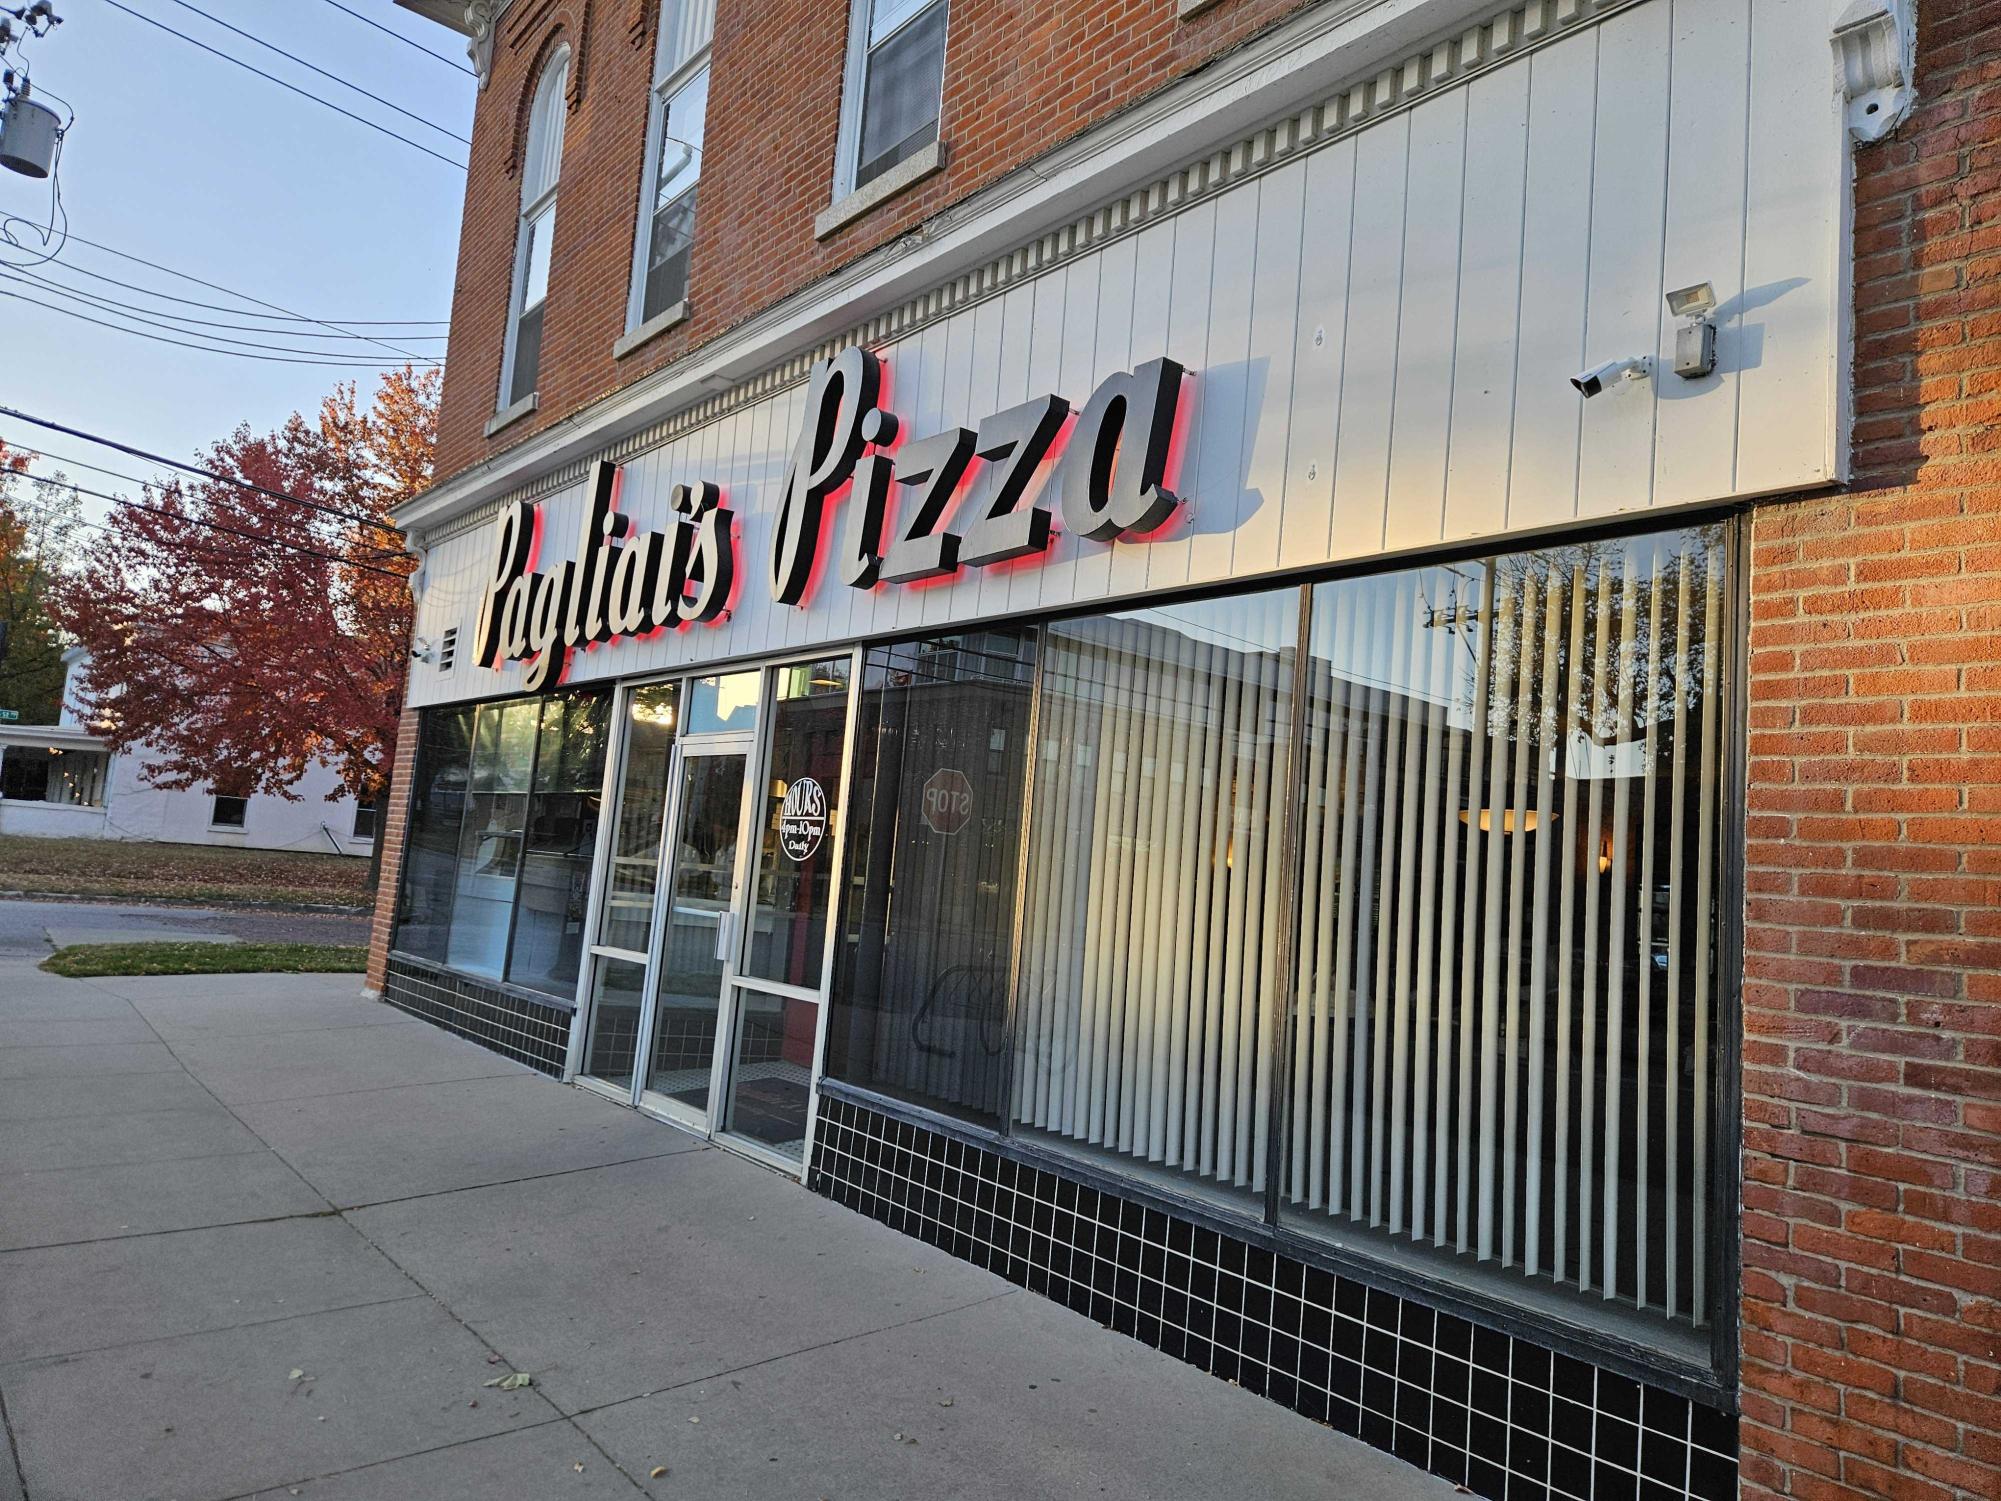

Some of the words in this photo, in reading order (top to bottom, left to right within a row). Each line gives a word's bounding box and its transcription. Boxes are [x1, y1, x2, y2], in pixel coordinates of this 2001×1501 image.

[471, 460, 733, 692] Pagliai's
[768, 345, 1184, 605] Pizza
[783, 780, 821, 816] HOURS
[788, 840, 809, 855] Daily
